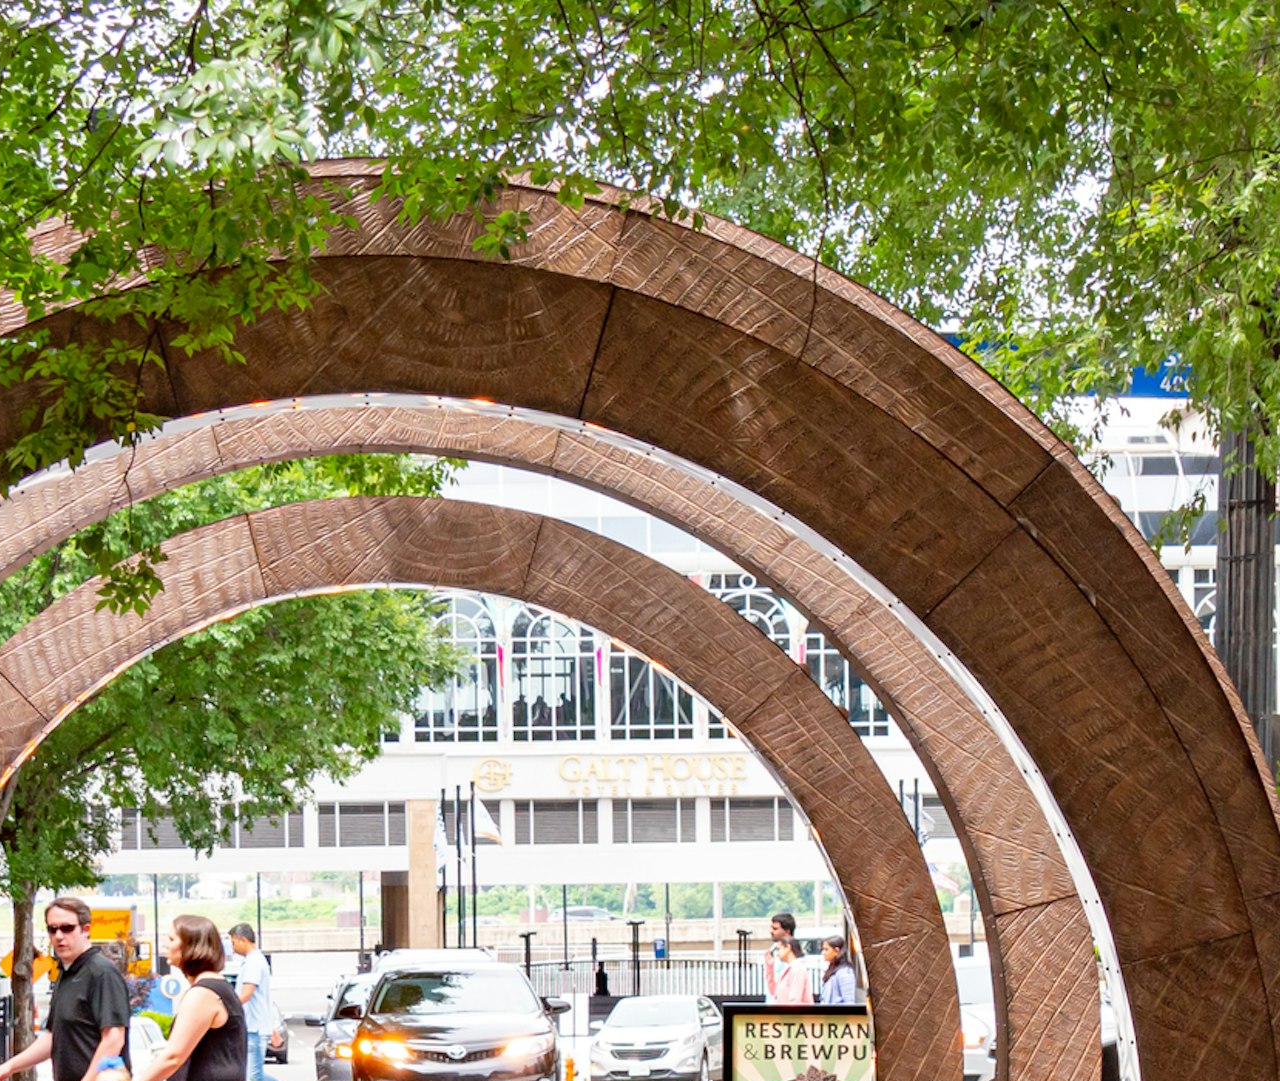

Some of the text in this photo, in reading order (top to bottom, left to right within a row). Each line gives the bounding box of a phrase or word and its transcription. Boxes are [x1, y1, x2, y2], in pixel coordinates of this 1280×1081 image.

[558, 752, 748, 783] GALT HOUSE
[745, 1022, 869, 1039] RESTAURAN
[764, 1044, 867, 1060] BREWPU
